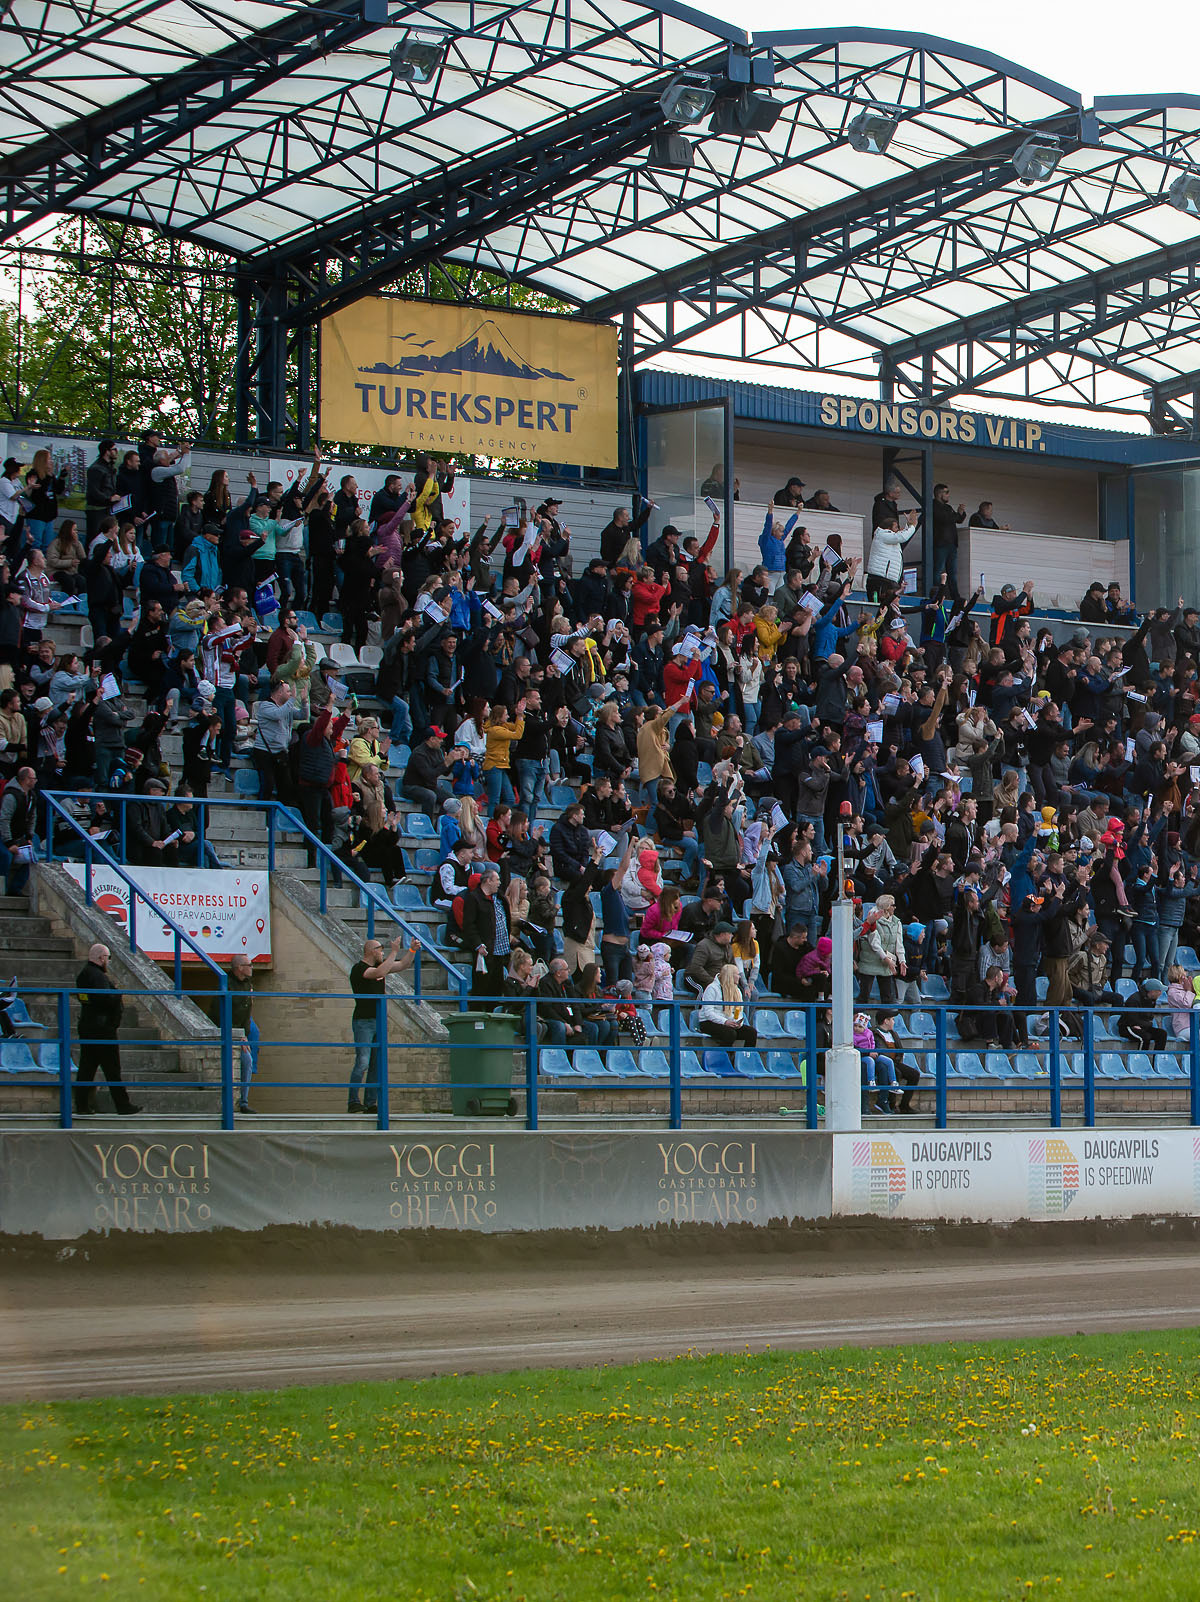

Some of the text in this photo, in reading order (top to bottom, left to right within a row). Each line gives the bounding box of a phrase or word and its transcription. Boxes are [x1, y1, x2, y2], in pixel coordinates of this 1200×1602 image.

[354, 383, 579, 433] TUREKSPERT
[820, 397, 1046, 451] SPONSORS V.I.P.
[409, 432, 538, 452] TRAVEL AGENCY
[229, 896, 247, 908] LTD
[94, 1143, 210, 1179] YOGGI
[389, 1143, 495, 1178] YOGGI
[658, 1142, 756, 1175] YOGGI
[912, 1142, 992, 1162] DAUGAVPILS
[1084, 1140, 1159, 1159] DAUGAVPILS
[912, 1169, 970, 1190] IR SPORTS
[1085, 1166, 1154, 1186] IS SPEEDWAY
[113, 1197, 200, 1229] BEAR
[407, 1194, 484, 1225] BEAR
[674, 1190, 743, 1220] BEAR
